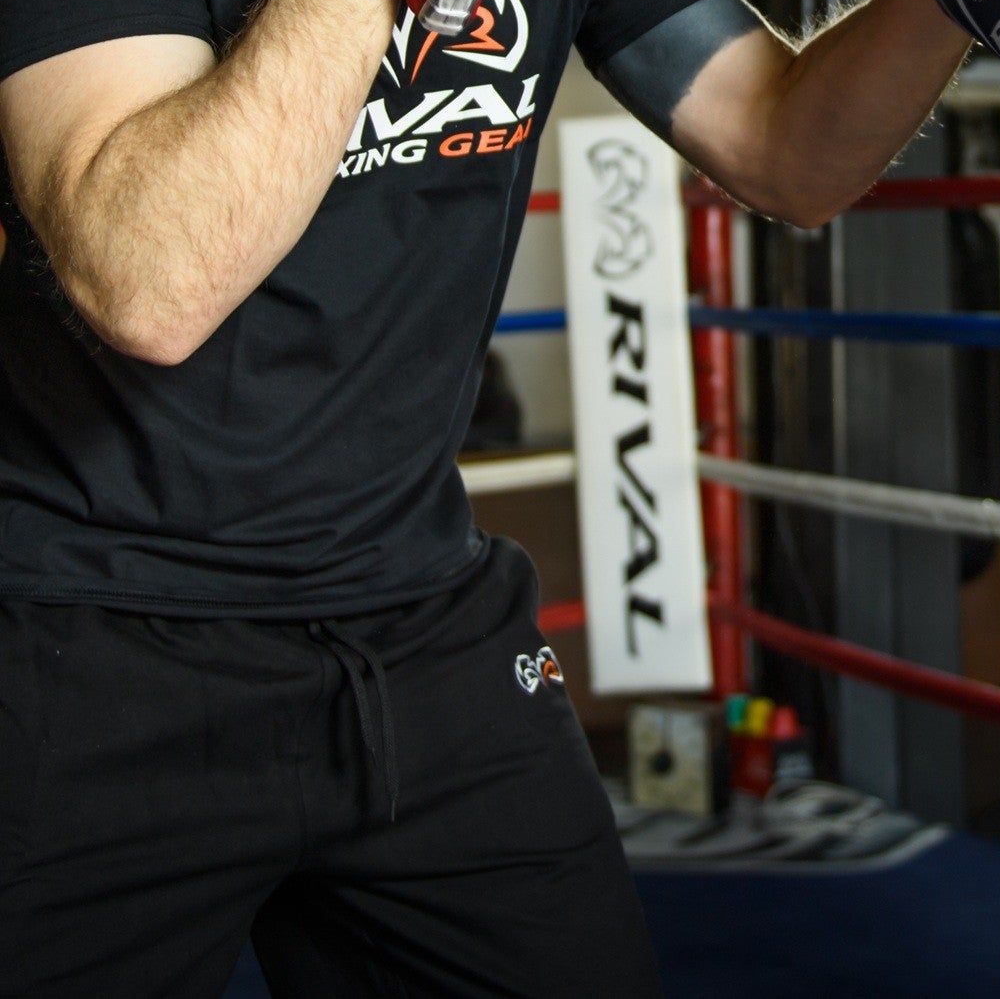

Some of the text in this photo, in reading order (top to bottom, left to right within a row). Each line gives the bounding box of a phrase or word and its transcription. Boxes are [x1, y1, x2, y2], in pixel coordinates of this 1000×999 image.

[347, 74, 540, 151] IVAL
[336, 138, 428, 178] XING
[603, 293, 665, 657] RIVAL
